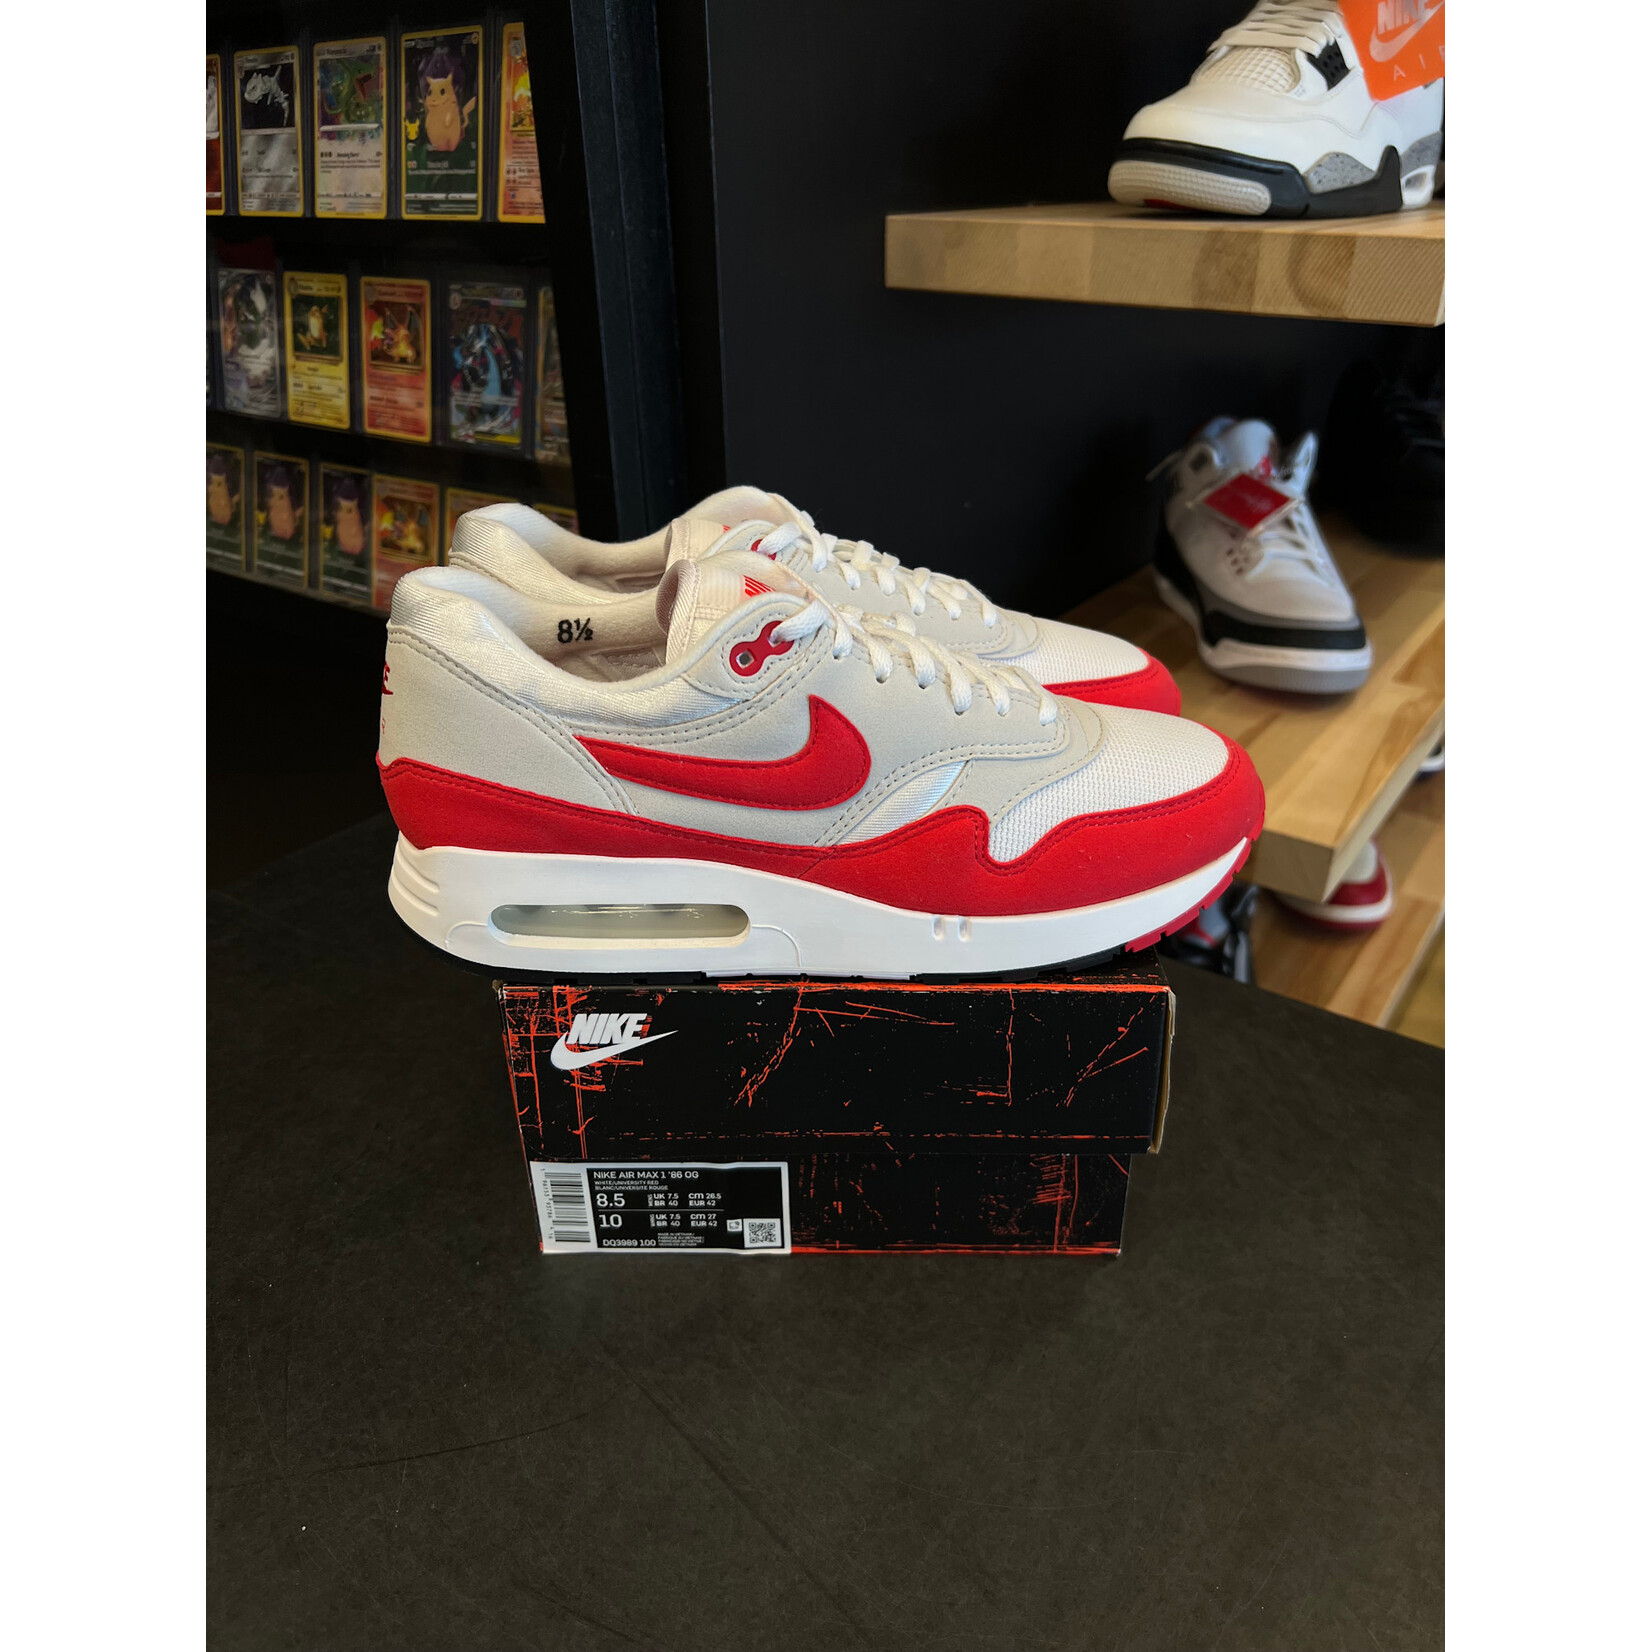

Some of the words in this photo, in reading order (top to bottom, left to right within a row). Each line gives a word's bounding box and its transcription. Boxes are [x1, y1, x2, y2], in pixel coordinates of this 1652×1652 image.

[1377, 0, 1434, 35] NIKE
[566, 1013, 648, 1045] NIKE
[593, 1171, 617, 1179] NIKE
[618, 1171, 635, 1179] AIR
[637, 1171, 660, 1179] MAX
[660, 1171, 667, 1179] 1
[684, 1171, 699, 1179] OG
[596, 1193, 626, 1207] 8.5
[598, 1213, 623, 1228] 10
[602, 1239, 638, 1247] DQ3989
[639, 1239, 657, 1247] 100
